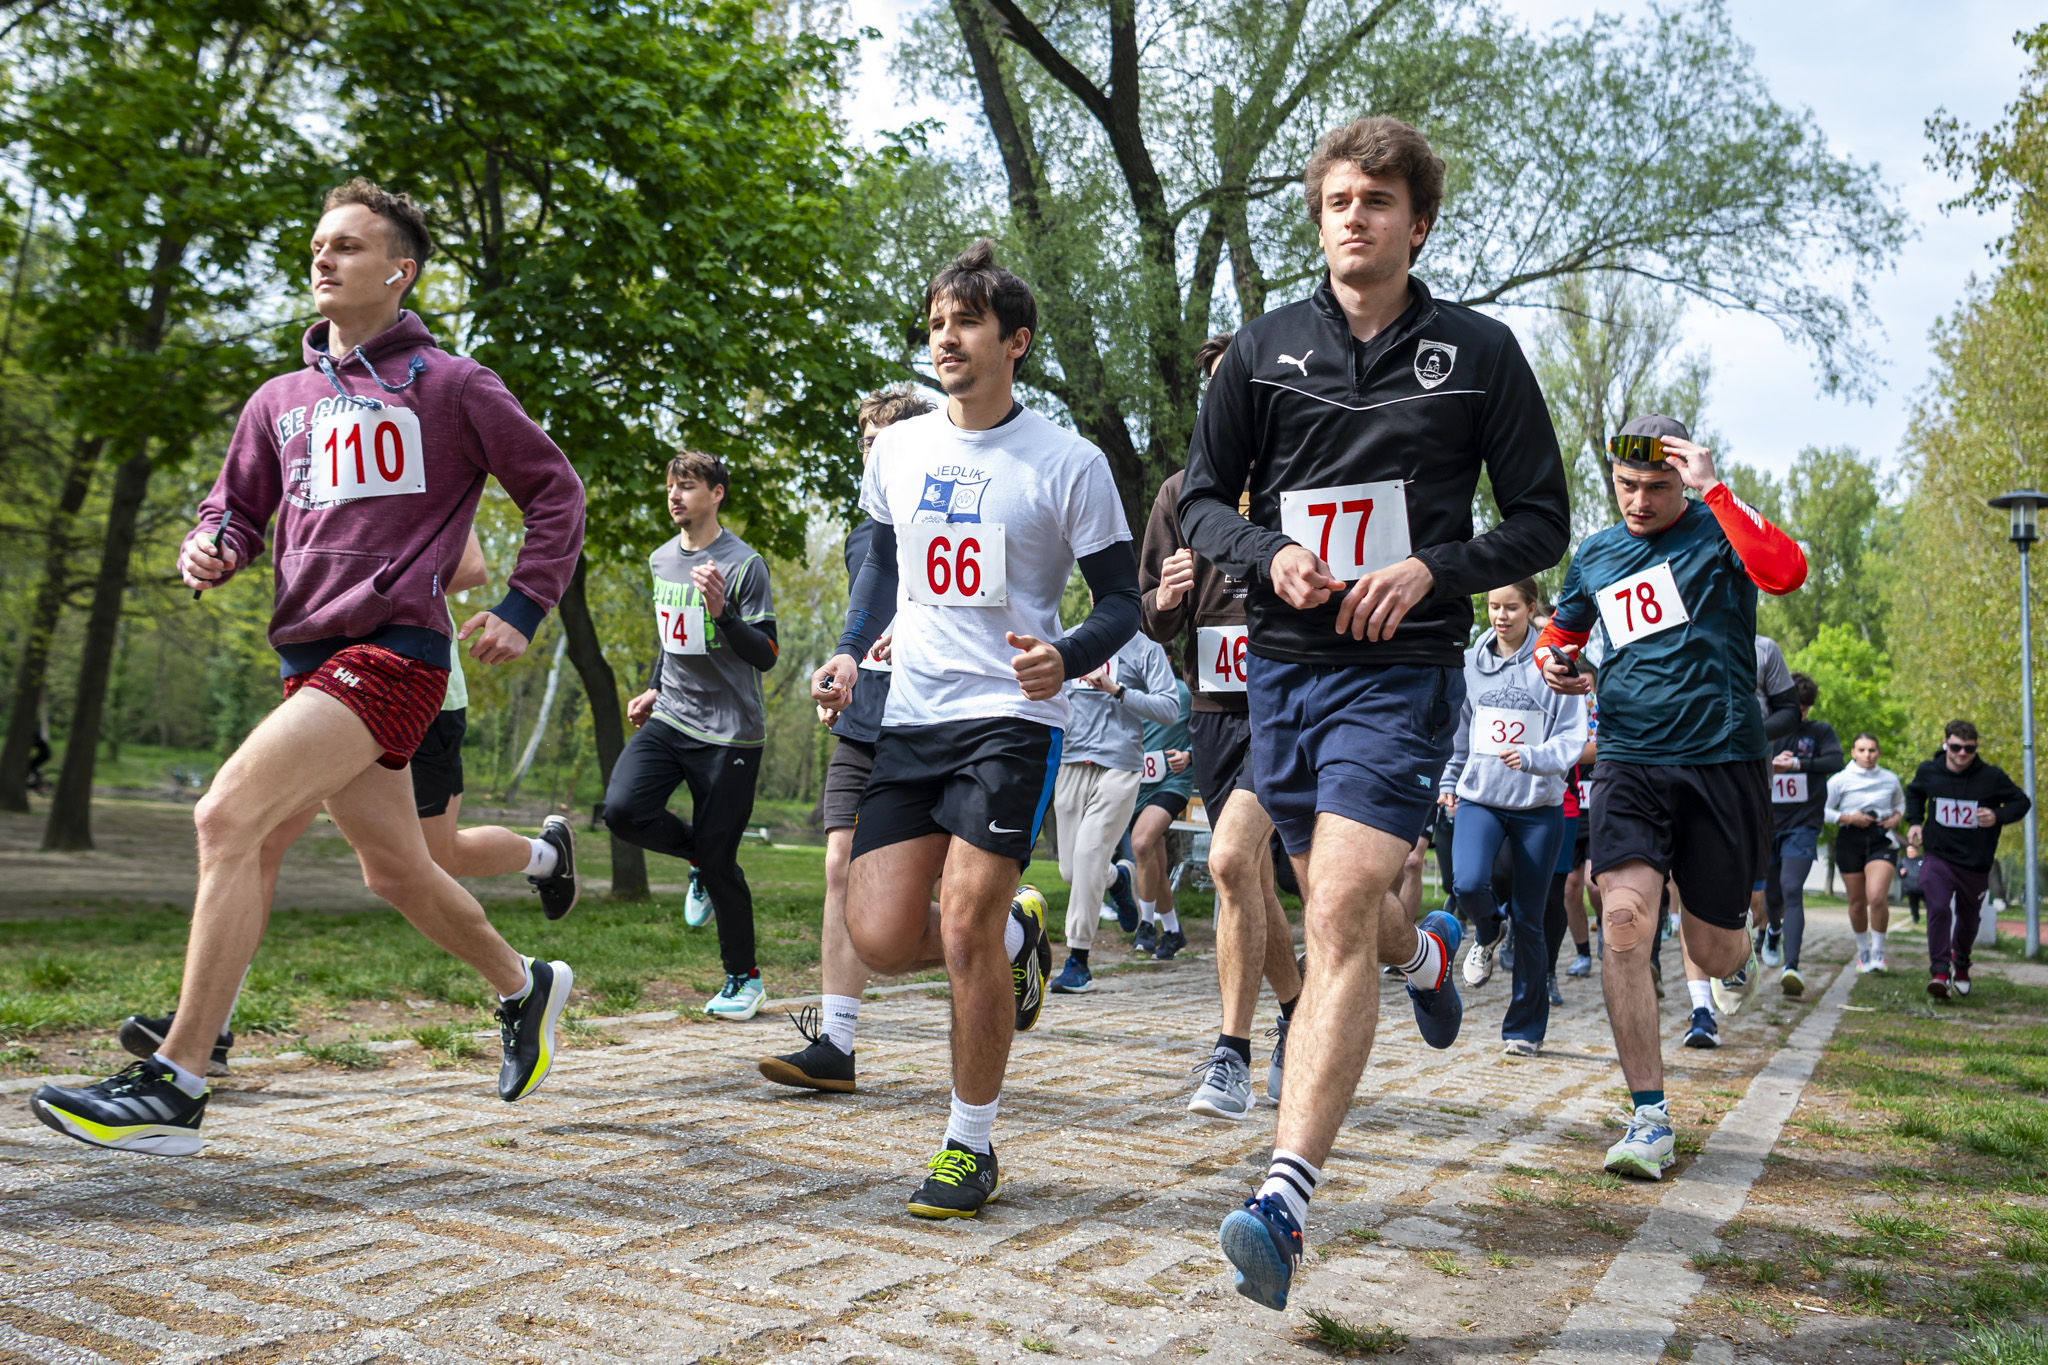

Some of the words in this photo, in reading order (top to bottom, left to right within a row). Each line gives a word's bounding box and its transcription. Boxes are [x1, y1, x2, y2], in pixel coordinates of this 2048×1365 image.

[325, 420, 404, 487] 110
[934, 465, 986, 481] JEDLIK
[1308, 498, 1374, 566] 77
[1614, 581, 1663, 632] 78
[661, 611, 687, 646] 74
[1215, 635, 1248, 682] 46
[1491, 720, 1525, 744] 32
[1142, 756, 1156, 778] 8
[1775, 777, 1797, 798] 16
[1941, 805, 1973, 825] 112
